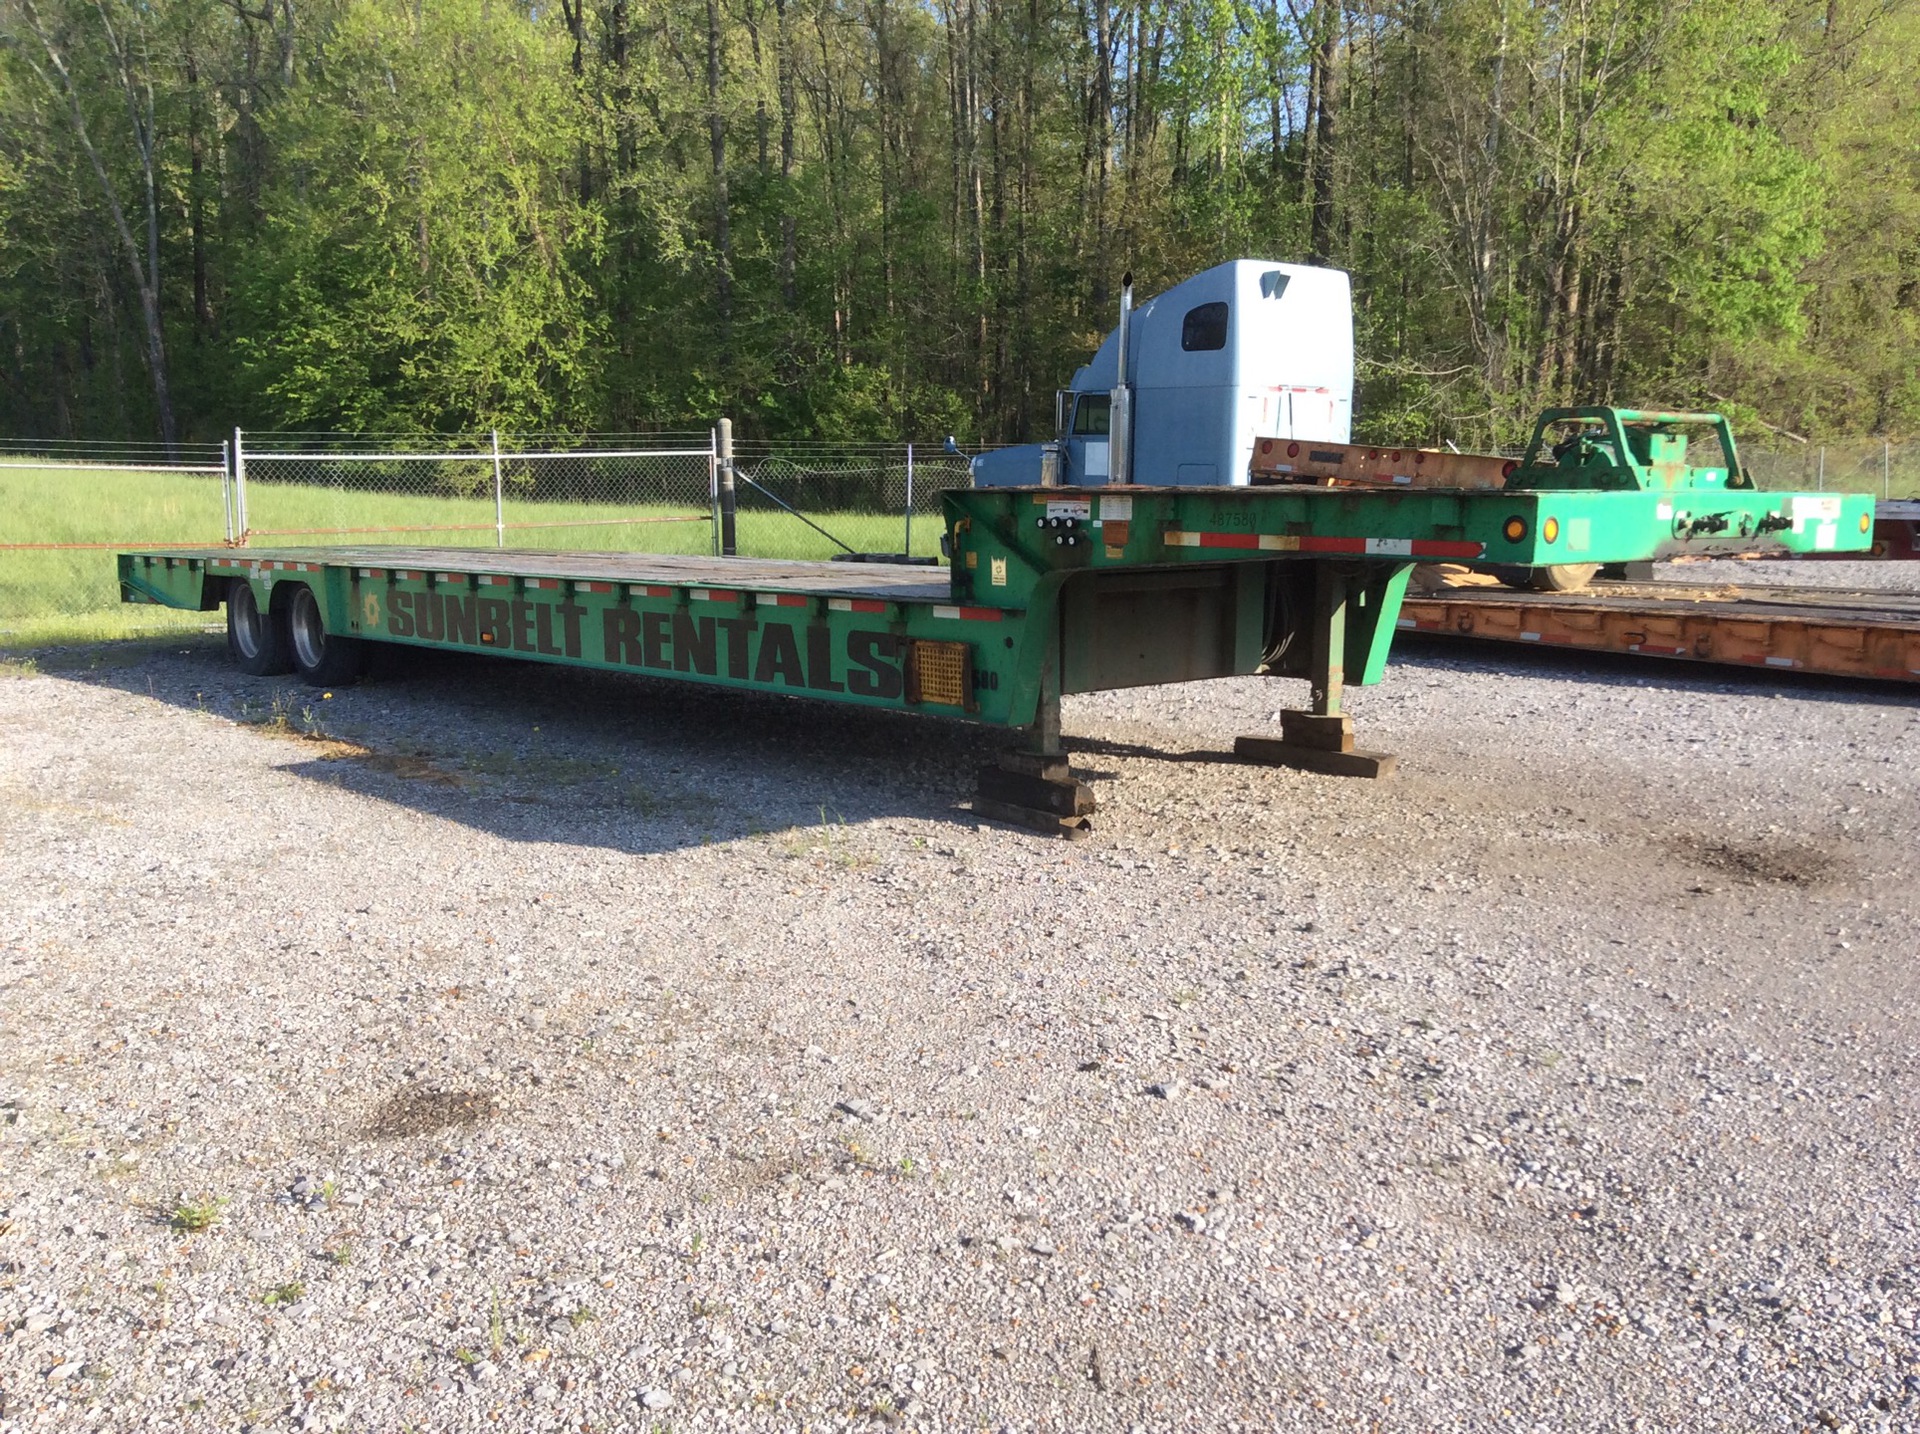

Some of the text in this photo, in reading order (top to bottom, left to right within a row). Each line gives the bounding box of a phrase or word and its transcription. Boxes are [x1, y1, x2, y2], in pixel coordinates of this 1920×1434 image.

[1209, 512, 1257, 527] 487580
[386, 590, 902, 699] SUNBELT RENTALS
